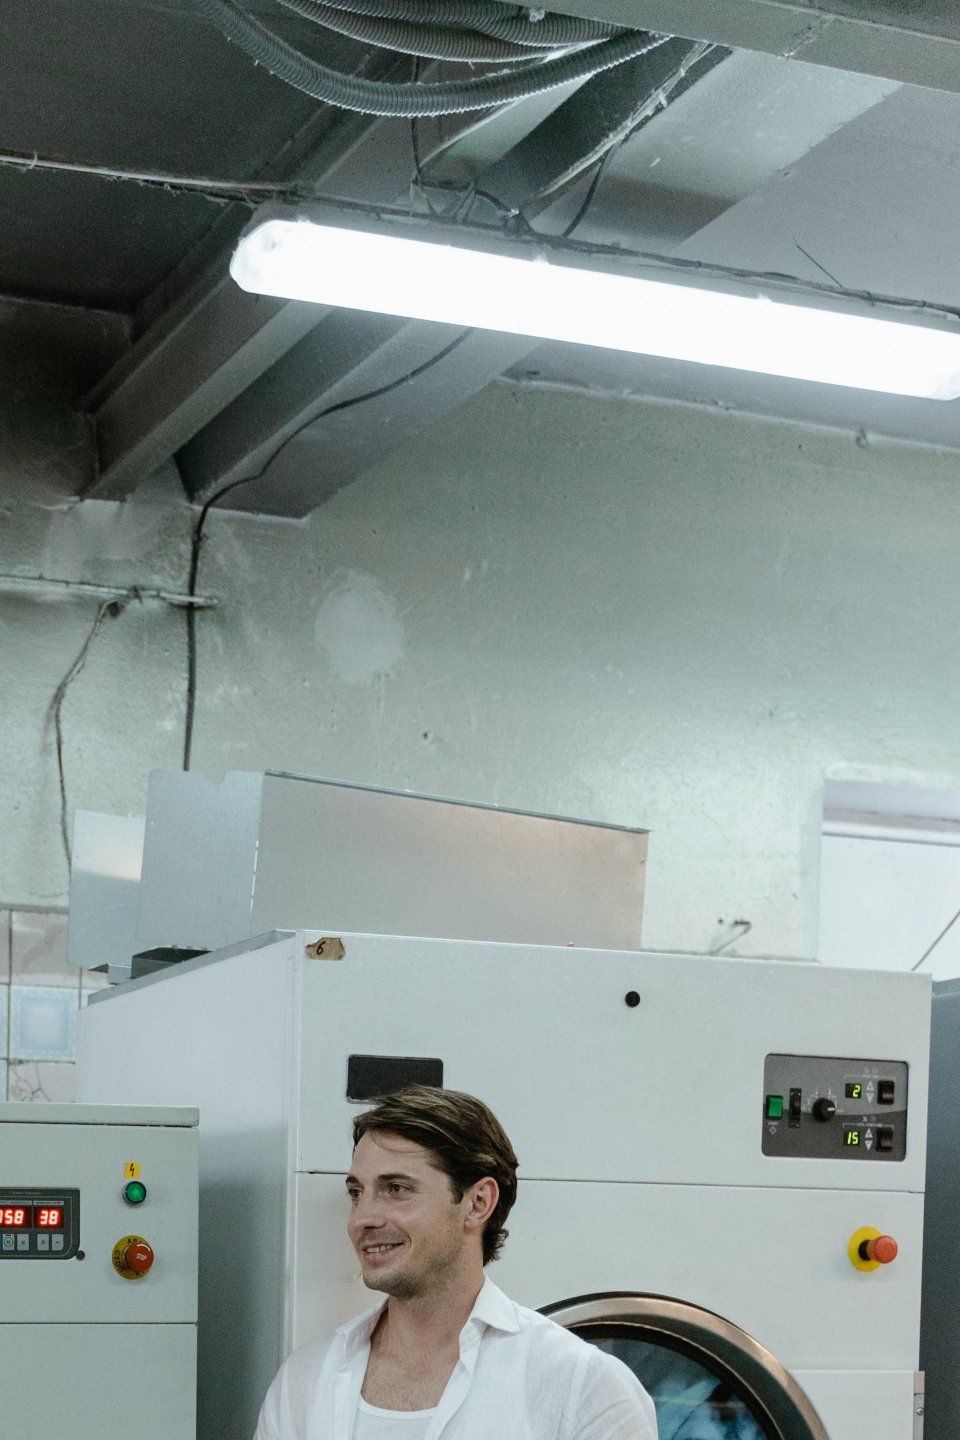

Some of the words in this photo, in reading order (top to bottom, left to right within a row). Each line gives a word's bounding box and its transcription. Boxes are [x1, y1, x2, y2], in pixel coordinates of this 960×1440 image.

[316, 941, 326, 955] 6
[852, 1084, 861, 1098] 2
[847, 1131, 859, 1145] 15
[40, 1209, 59, 1225] 38
